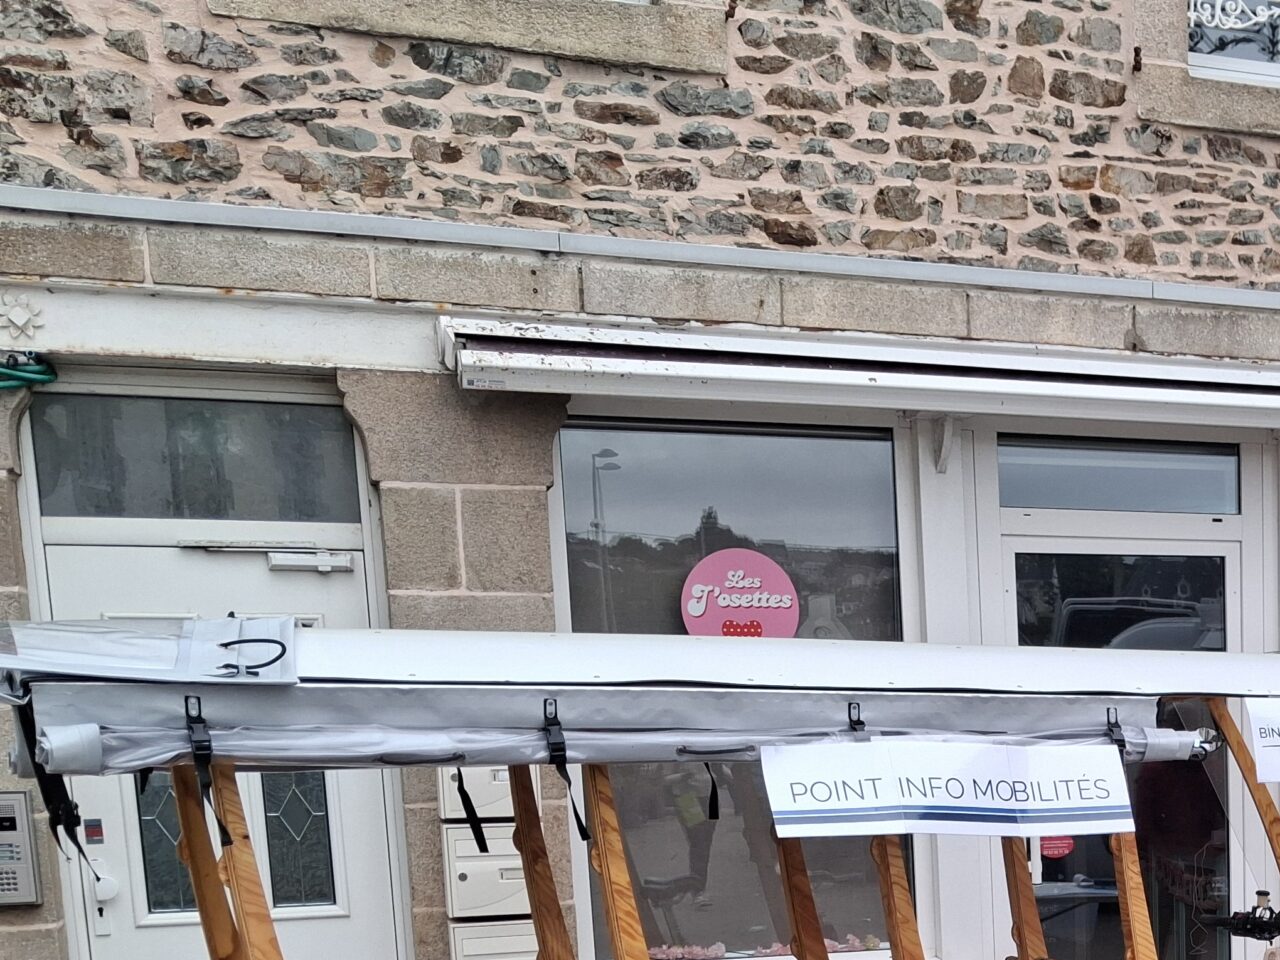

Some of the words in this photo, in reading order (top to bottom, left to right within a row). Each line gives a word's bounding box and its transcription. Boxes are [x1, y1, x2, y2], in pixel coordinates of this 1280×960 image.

[725, 569, 762, 588] Les
[790, 778, 882, 803] POINT
[899, 777, 965, 799] INFO
[973, 773, 1110, 802] MOBILITÉS
